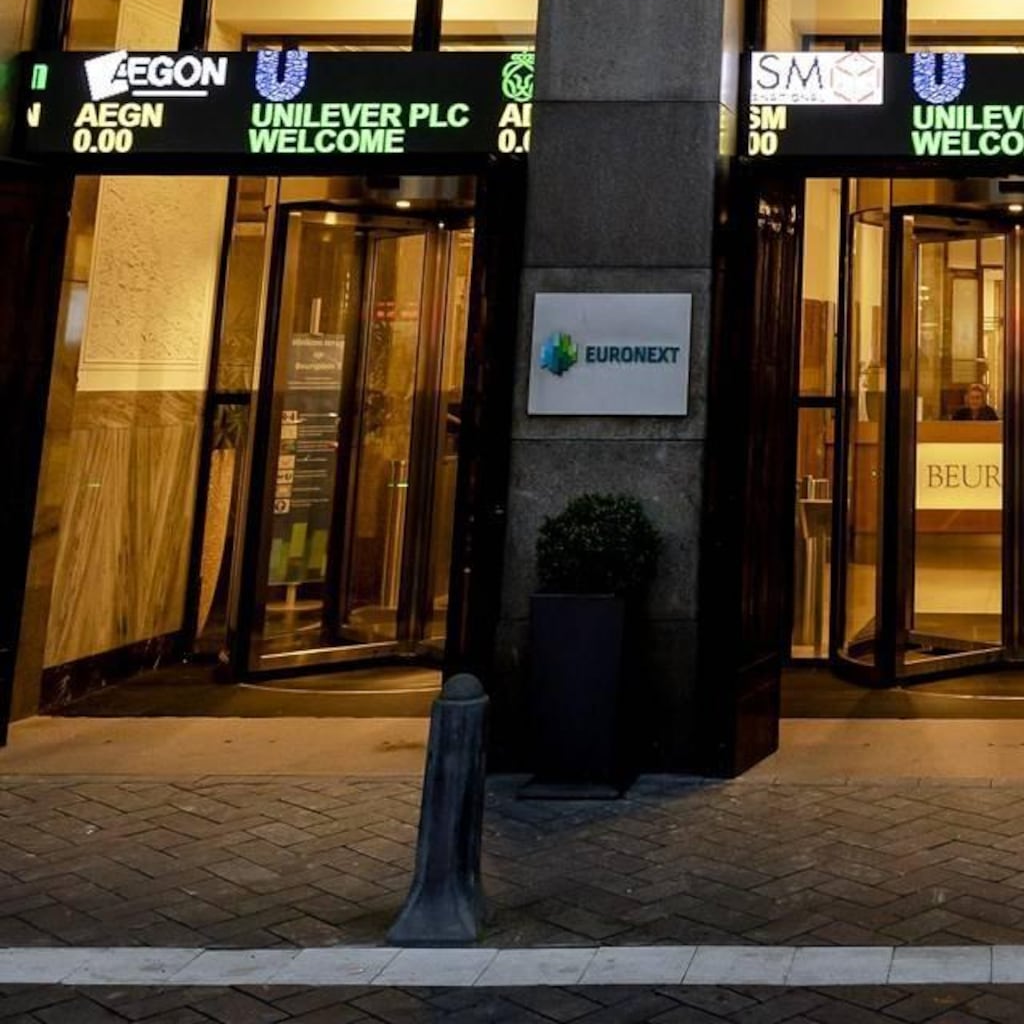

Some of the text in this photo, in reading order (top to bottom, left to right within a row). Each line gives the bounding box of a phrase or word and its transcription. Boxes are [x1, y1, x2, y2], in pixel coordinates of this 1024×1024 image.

[110, 55, 228, 88] AEGON
[73, 102, 165, 128] AEGN
[251, 103, 471, 128] UNILEVER PLC
[72, 128, 134, 154] 0.00
[248, 128, 405, 154] WELCOME
[584, 345, 681, 365] EURONEXT
